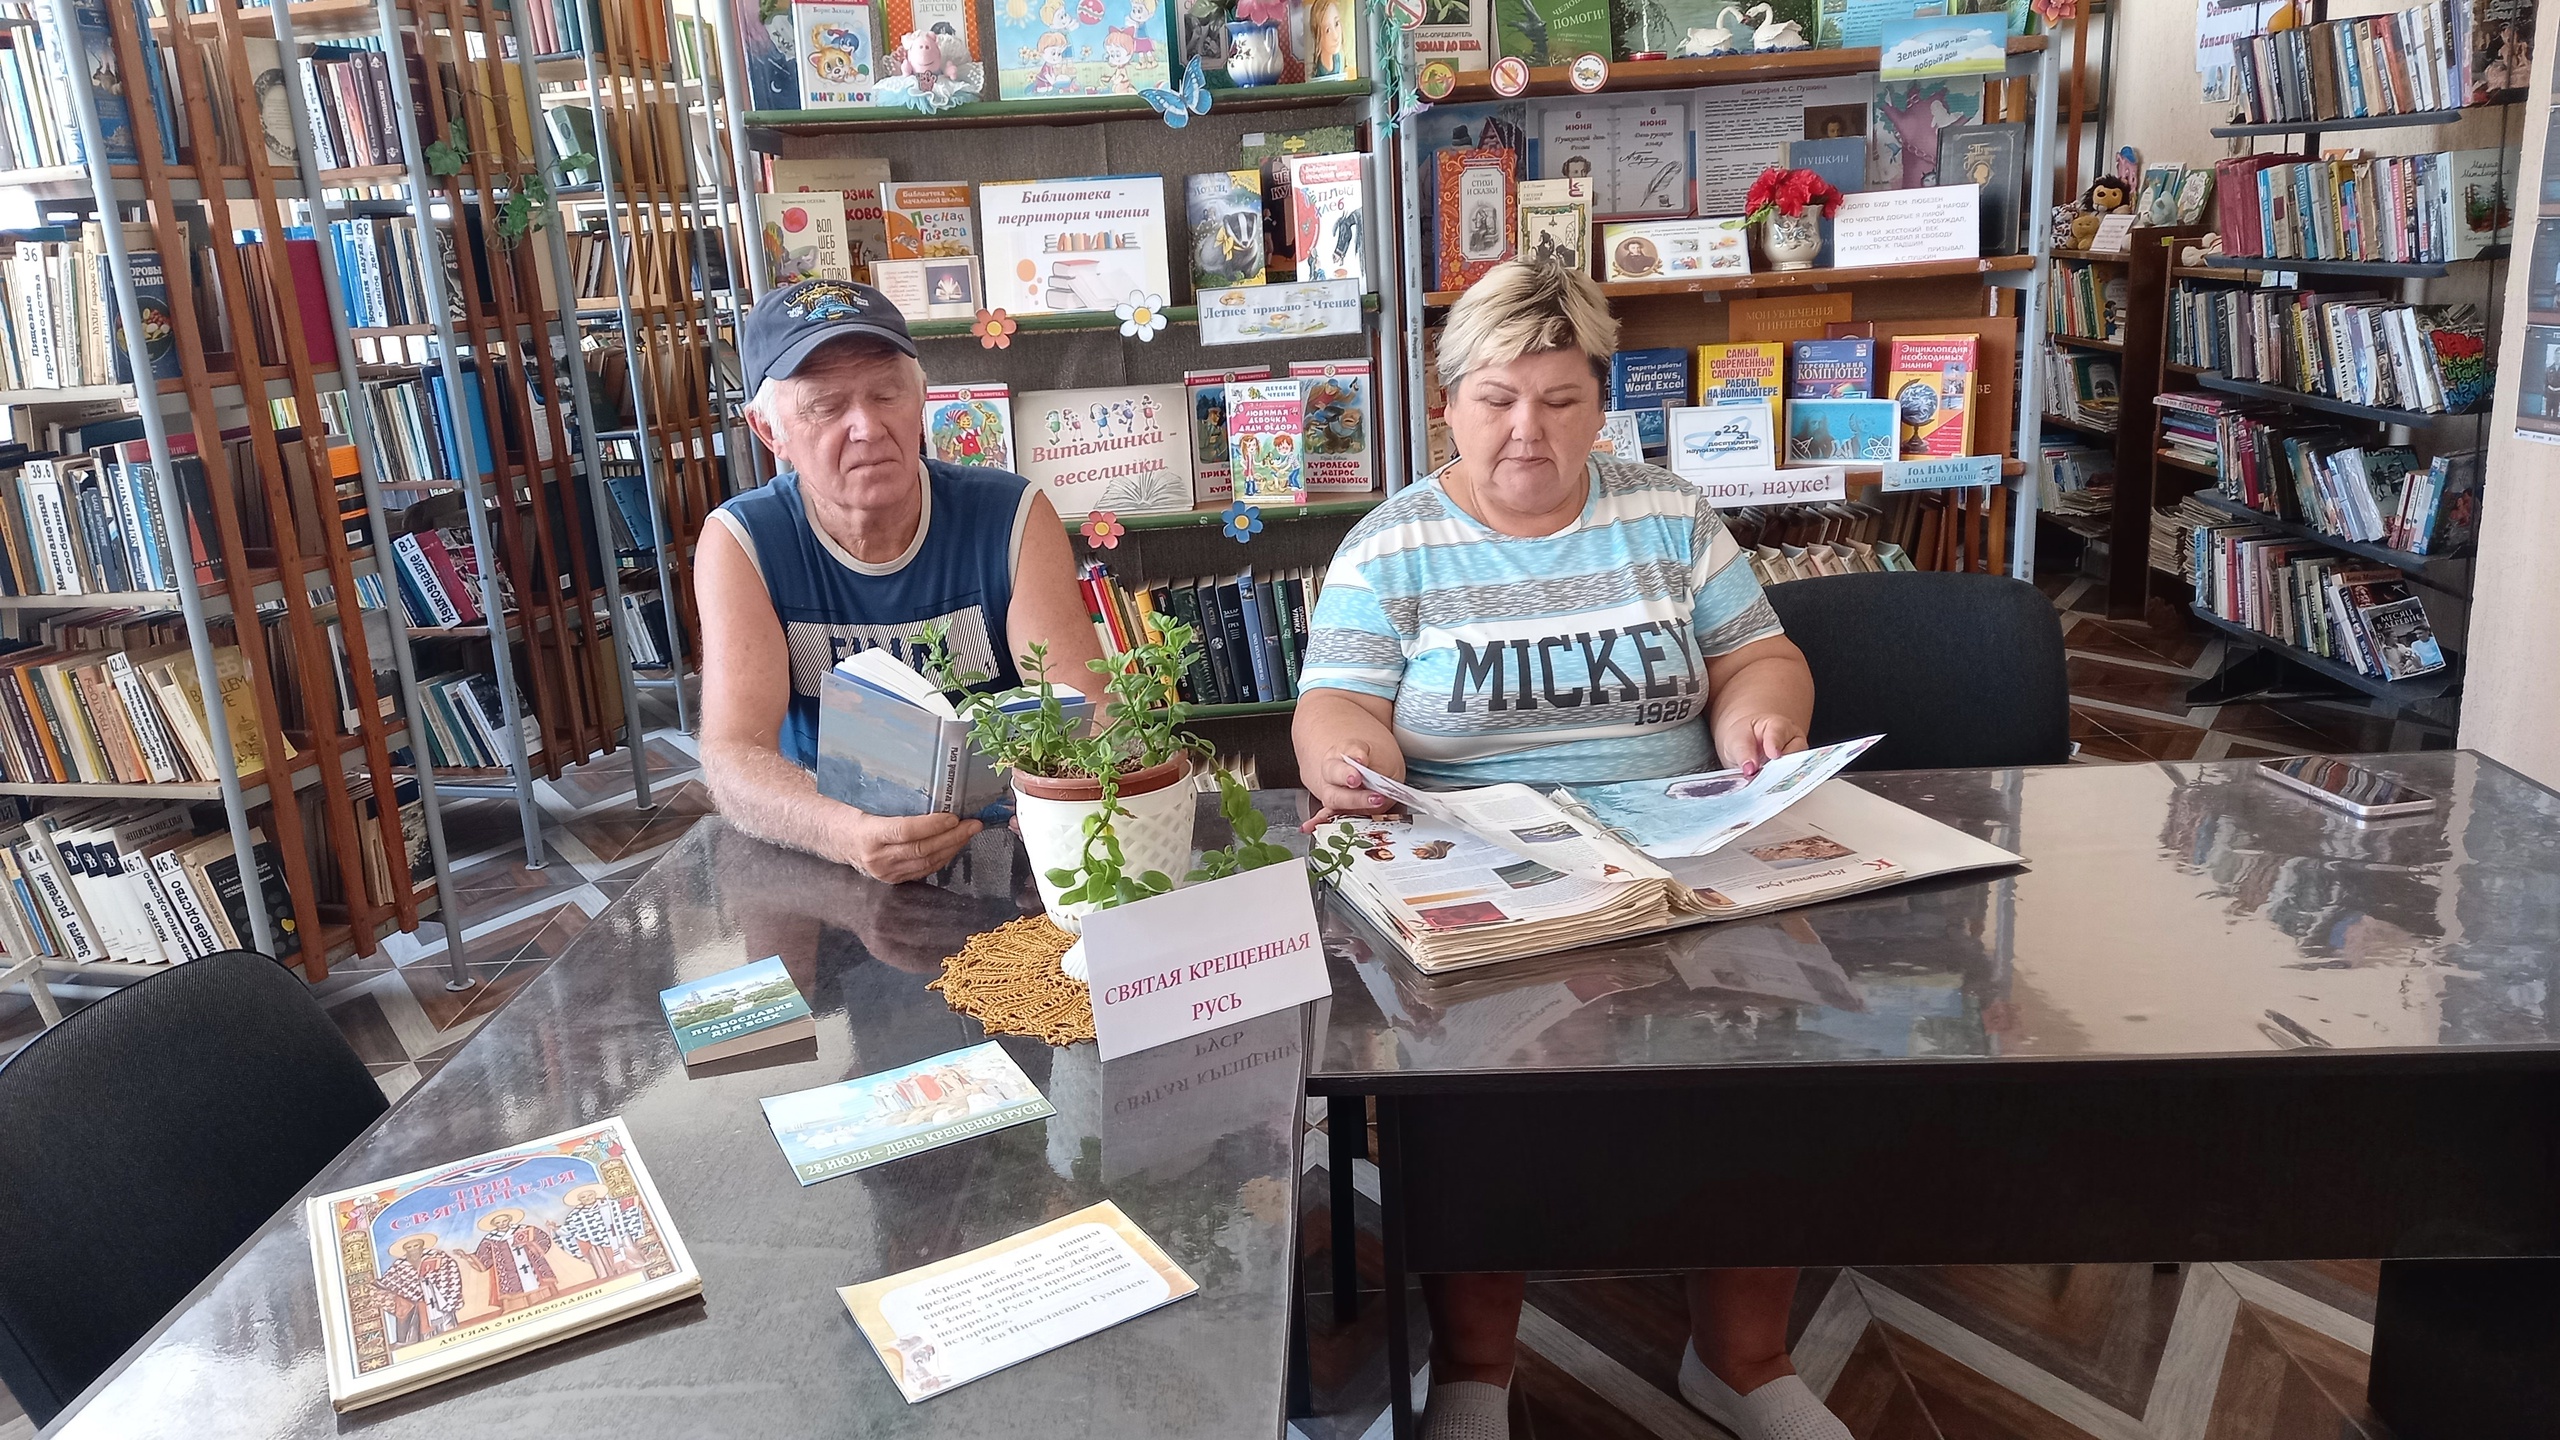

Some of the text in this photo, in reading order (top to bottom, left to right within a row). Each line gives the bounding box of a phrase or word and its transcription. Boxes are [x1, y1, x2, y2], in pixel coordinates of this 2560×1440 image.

[813, 6, 830, 15] Борис
[919, 4, 957, 13] ДЕТСТВО
[1553, 9, 1606, 30] ПОМОГИ!
[1897, 39, 1950, 62] Зеленый мир
[1913, 50, 1958, 73] добрый дом
[811, 92, 871, 102] КИТ И КОТ
[1741, 84, 1828, 96] Биография Пушкина
[1575, 111, 1581, 119] 6
[1650, 107, 1657, 115] 6
[1799, 154, 1849, 165] ПУШКИН
[1471, 179, 1493, 188] СТИХИ
[1473, 187, 1498, 195] СКАЗКИ
[1021, 189, 1111, 204] Библиотека
[1847, 202, 1870, 211] ДОЛГО
[1911, 197, 1944, 205] ЛЮБЕЗЕН
[911, 210, 965, 227] Лесная
[998, 207, 1150, 227] территория чтения
[1855, 215, 1885, 223] ЧУВСТВА
[1886, 213, 1913, 221] ДОБРЫЕ
[816, 218, 833, 233] ВОЛ
[1885, 226, 1922, 235] ЖЕСТОКИЙ
[818, 235, 836, 250] ШЕБ
[1850, 240, 1924, 251] МИЛОСТЬ ПАДШИМ
[1873, 235, 1913, 243] ВОССЛАВИЛ
[23, 246, 38, 262] 36
[820, 251, 836, 266] НОЕ
[364, 279, 376, 323] Военная
[1204, 298, 1357, 319] Летнее приклю Чтение
[1773, 306, 1834, 320] УВЛЕЧЕНИЯ
[25, 295, 41, 357] Пищевые
[35, 273, 54, 380] производства
[1767, 318, 1822, 331] ИНТЕРЕСЫ
[1726, 348, 1760, 358] САМЫЙ
[1901, 344, 1968, 354] Энциклопедия
[1710, 357, 1775, 368] СОВРЕМЕННЫЙ
[1901, 353, 1964, 362] необходимых
[1627, 361, 1682, 372] Секреты работы
[1711, 367, 1774, 379] САМОУЧИТЕЛЬ
[1632, 371, 1681, 383] Windows,
[1725, 378, 1760, 388] РАБОТЫ
[1625, 380, 1685, 393] Word, Excel
[1719, 387, 1778, 399] КОМПЬЮТЕРЕ
[1245, 409, 1289, 417] ЛЮБИМАЯ
[1248, 416, 1287, 424] ДЕВОЧКА
[1723, 425, 1739, 433] 22
[1031, 429, 1164, 464] Витаминки
[30, 463, 51, 479] 39.6
[1053, 455, 1168, 487] веселинки
[1307, 461, 1360, 469] КУРОЛЕСОВ
[1927, 463, 1969, 474] НАУКИ
[1306, 476, 1369, 485] ОДКЛЮЧАЮТСЯ
[1763, 475, 1831, 498] науке!
[37, 494, 68, 592] Межпланетные
[50, 501, 75, 574] сообщения
[398, 538, 416, 553] 81
[410, 553, 456, 624] Языкознание
[2380, 608, 2413, 624] МЕСЯЦ
[1447, 617, 1700, 712] MICKEY
[85, 676, 110, 733] ТРАКТОРЫ
[1634, 700, 1692, 726] 1928
[28, 850, 43, 864] 44
[123, 855, 144, 874] 46.7
[154, 853, 180, 873] 46.8
[34, 872, 91, 959] Защита растений
[142, 902, 169, 943] Мелкое
[1104, 932, 1312, 1006] СВЯТАЯ КРЕЩЕННАЯ
[1192, 992, 1243, 1022] РУСЬ
[690, 1001, 795, 1037] ПРАВОСЛАВИЕ
[711, 1012, 782, 1039] ДЛЯ ВСЕХ
[805, 1101, 1045, 1176] 28 ИЮЛЯ ДЕНЬ КРЕЩЕНИЯ РУСИ
[449, 1175, 514, 1202] ТРИ
[391, 1169, 578, 1231] СВЯТИТЕЛЯ
[924, 1229, 1101, 1298] «Крещение дало нашим
[916, 1243, 1091, 1312] предкам высшую свободу
[922, 1243, 1116, 1321] свободу выбора между Добром
[996, 1284, 1041, 1307] победа
[1044, 1252, 1124, 1293] православия
[439, 1287, 604, 1348] ДЕТЯМ ПРАВОСЛАВИИ
[936, 1309, 1000, 1340] подарила
[1002, 1296, 1034, 1318] Руси
[979, 1332, 1006, 1347] Лев
[1007, 1296, 1089, 1336] Николаевич
